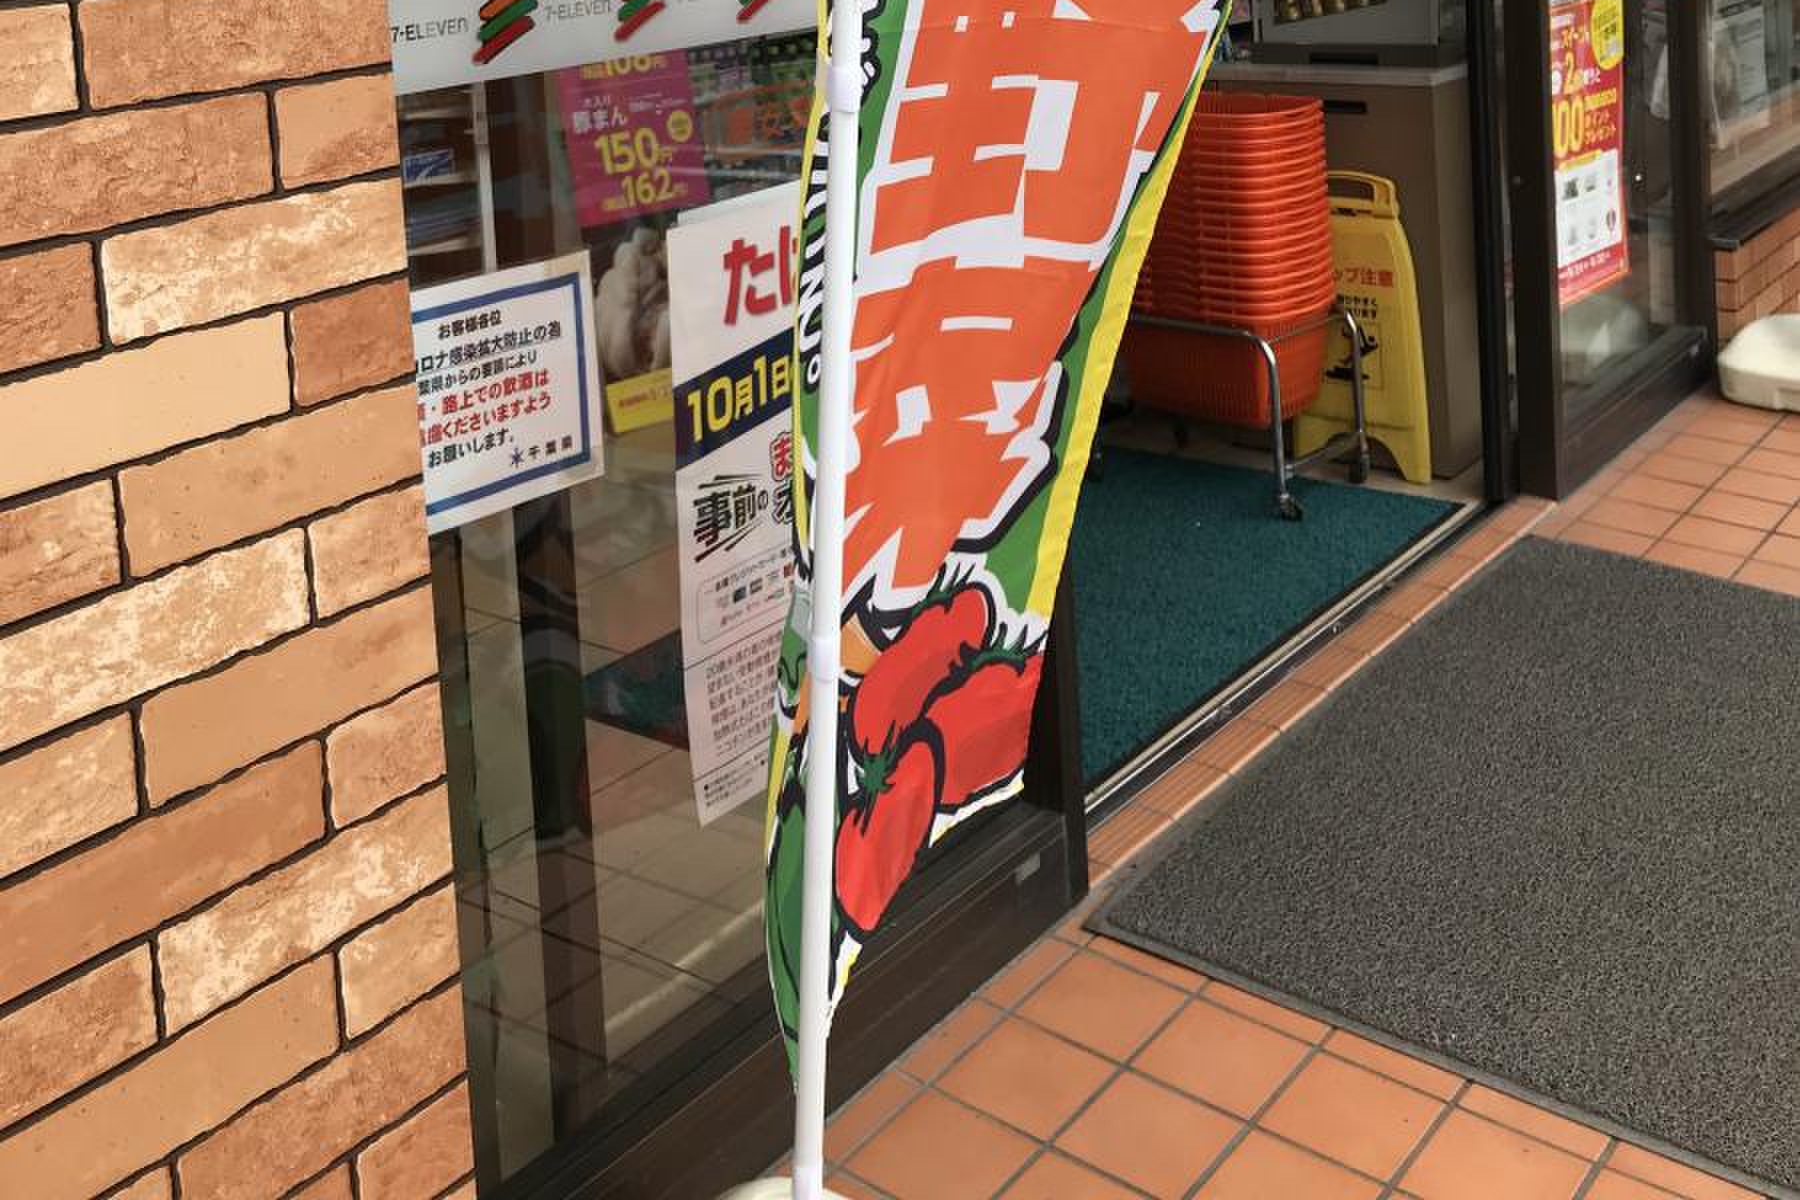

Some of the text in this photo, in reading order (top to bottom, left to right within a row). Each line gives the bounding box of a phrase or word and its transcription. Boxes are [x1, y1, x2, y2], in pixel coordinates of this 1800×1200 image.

[438, 310, 502, 340] お客様各位
[688, 354, 790, 444] 10月1日
